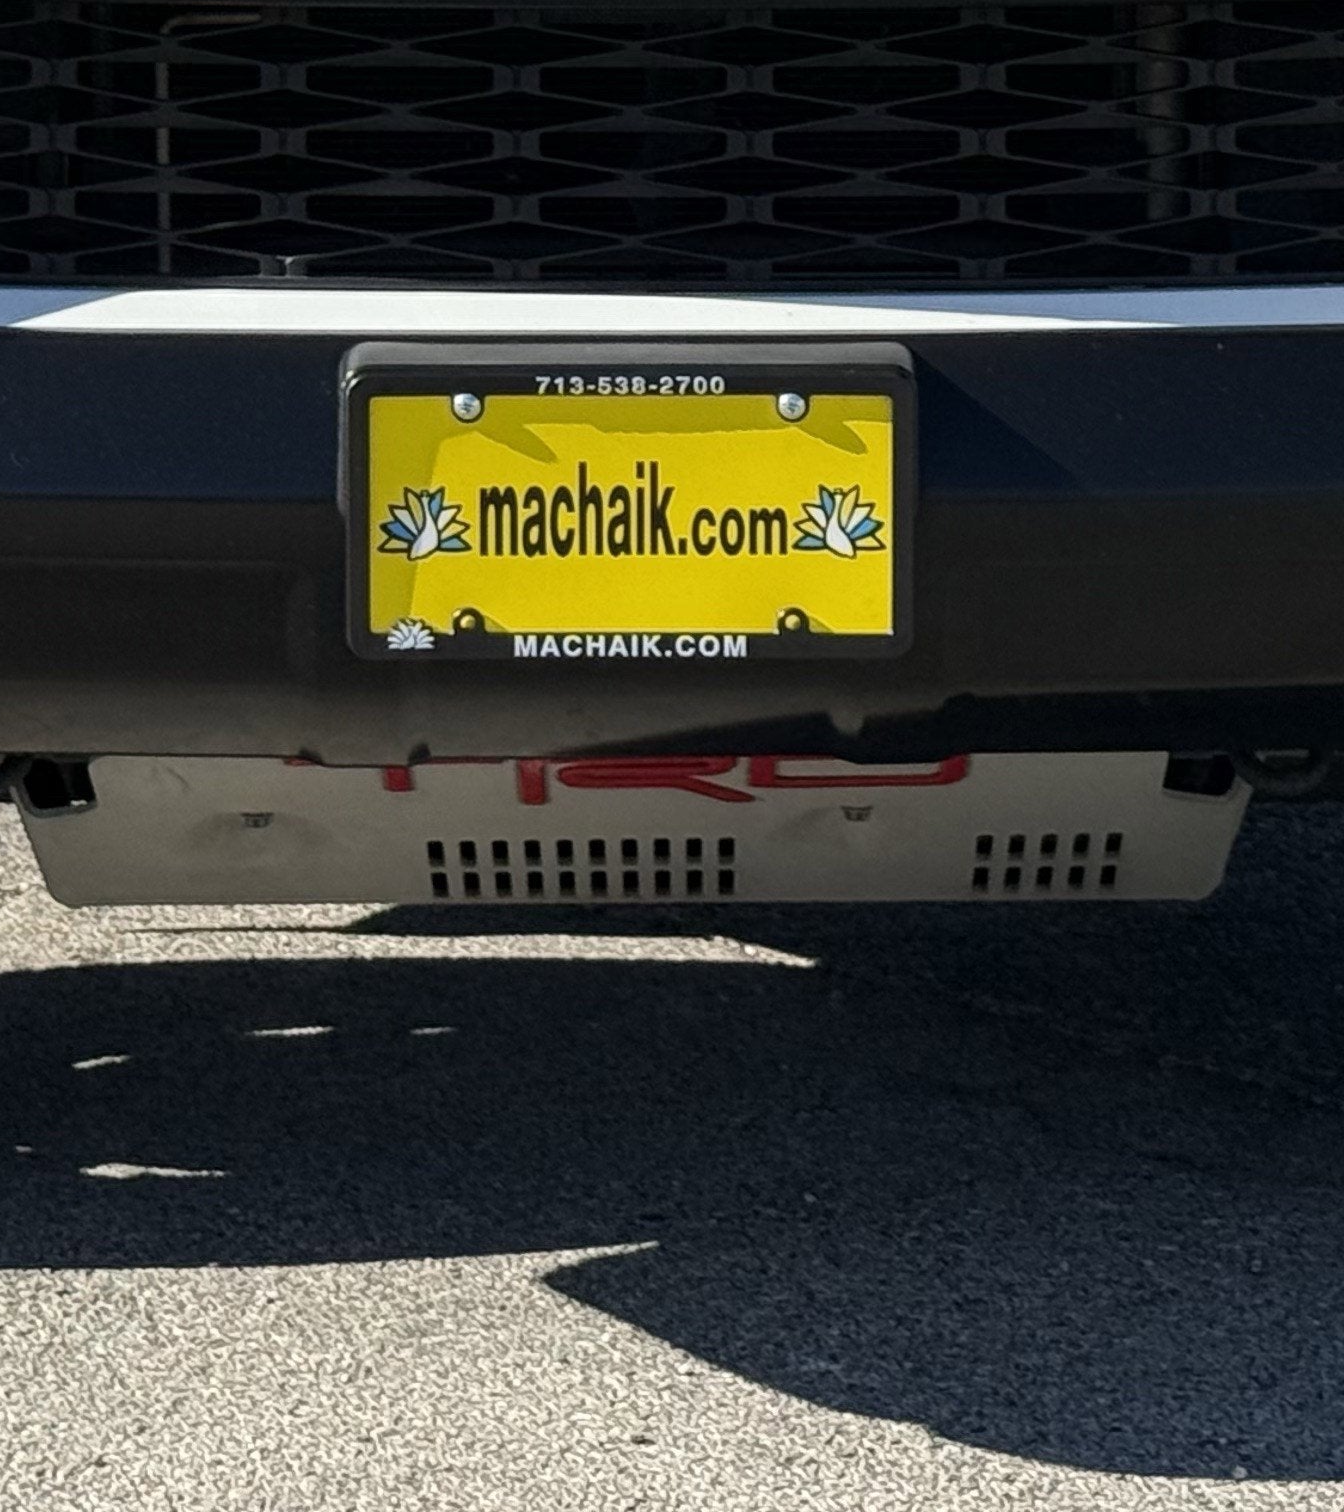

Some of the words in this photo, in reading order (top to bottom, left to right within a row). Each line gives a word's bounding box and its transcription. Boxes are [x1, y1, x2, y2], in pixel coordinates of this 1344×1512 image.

[535, 376, 725, 396] 713-538-2700
[478, 461, 788, 557] machaik.com
[513, 635, 748, 659] MACHAIK.COM
